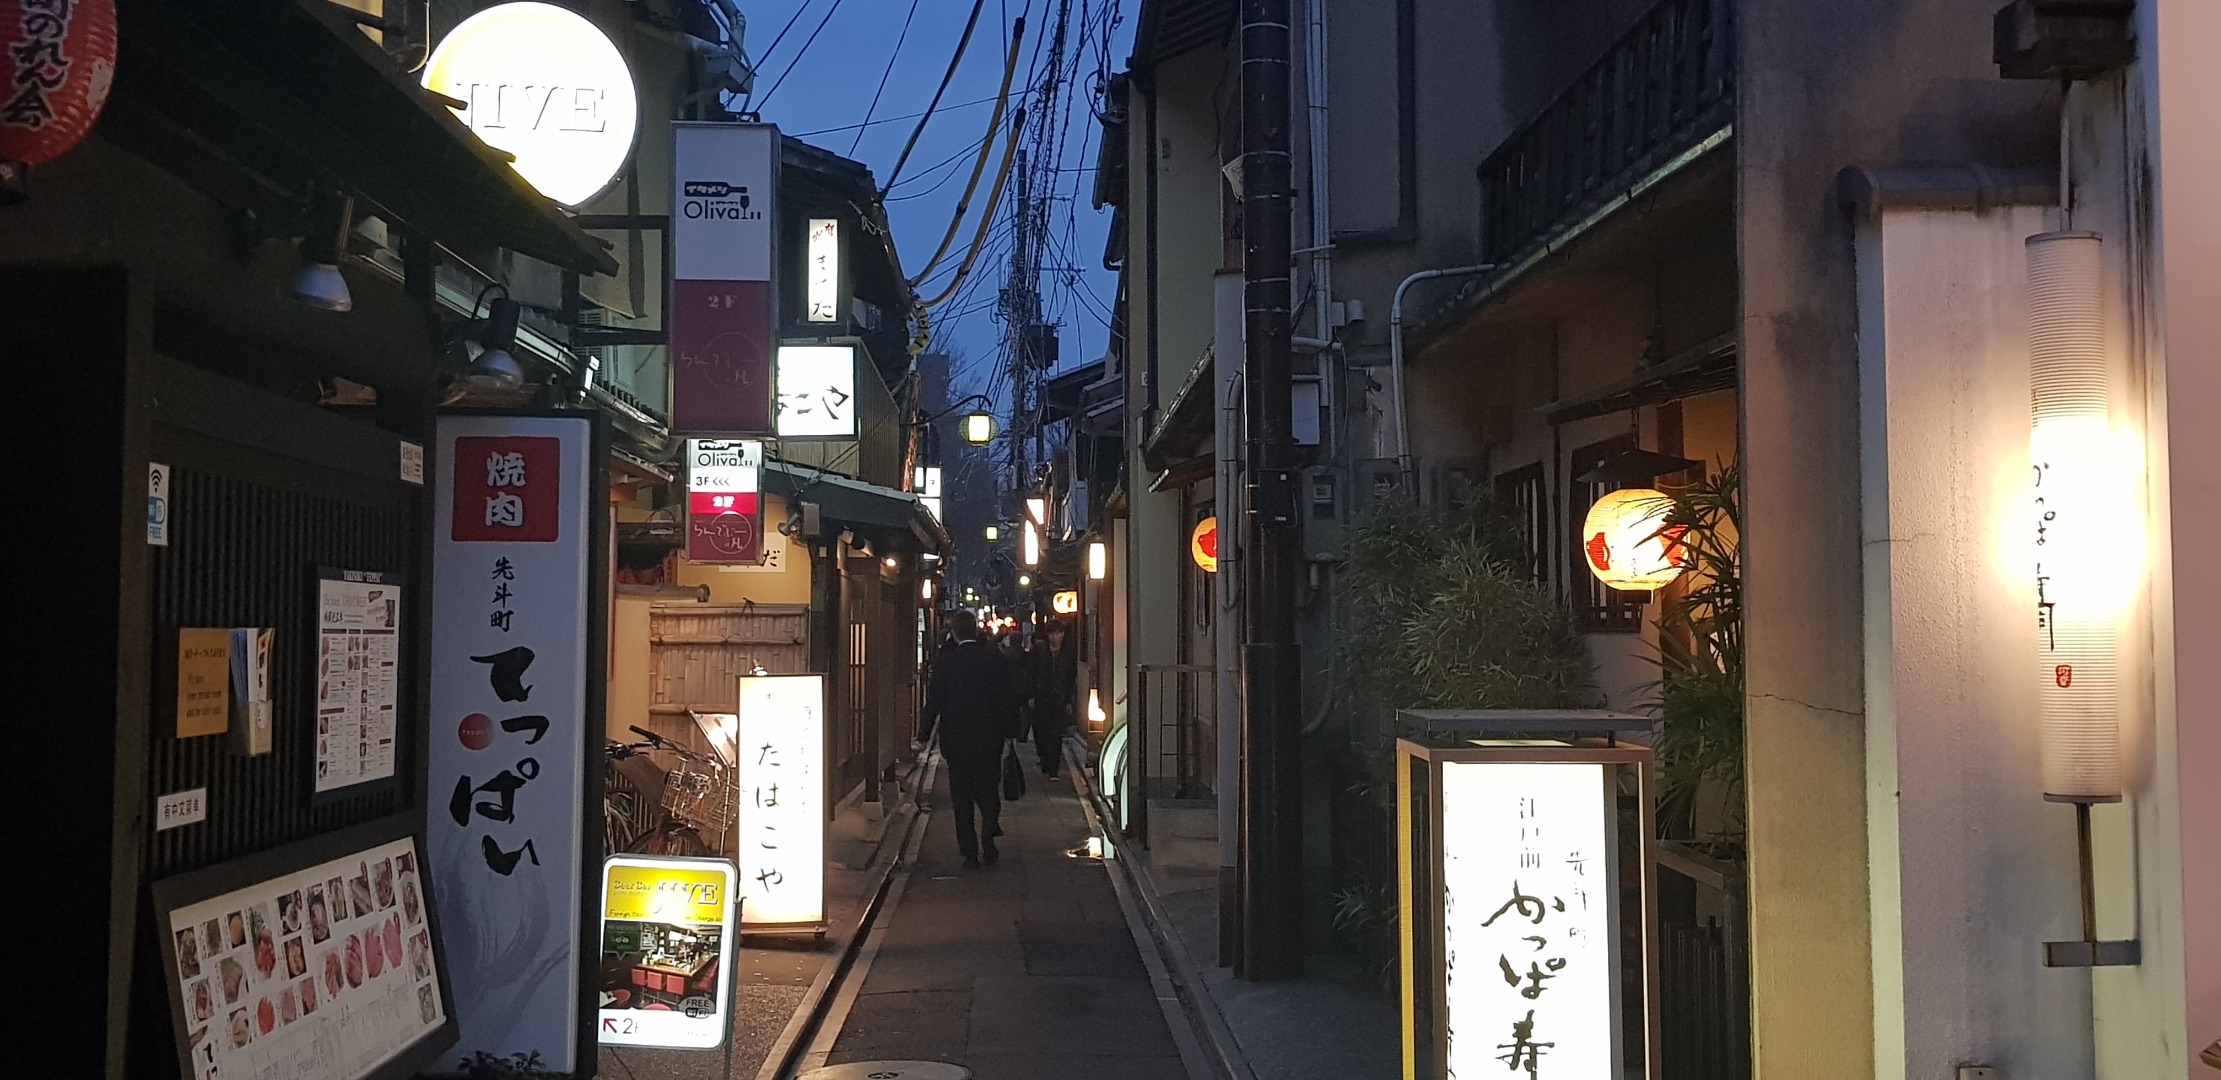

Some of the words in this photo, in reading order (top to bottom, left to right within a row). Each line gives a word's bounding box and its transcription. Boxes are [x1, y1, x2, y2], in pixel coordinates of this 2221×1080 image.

[485, 451, 526, 527] 焼肉
[696, 476, 710, 486] 3F
[490, 556, 516, 633] 先斗町
[449, 646, 550, 876] てっぱい
[686, 999, 709, 1008] FREE
